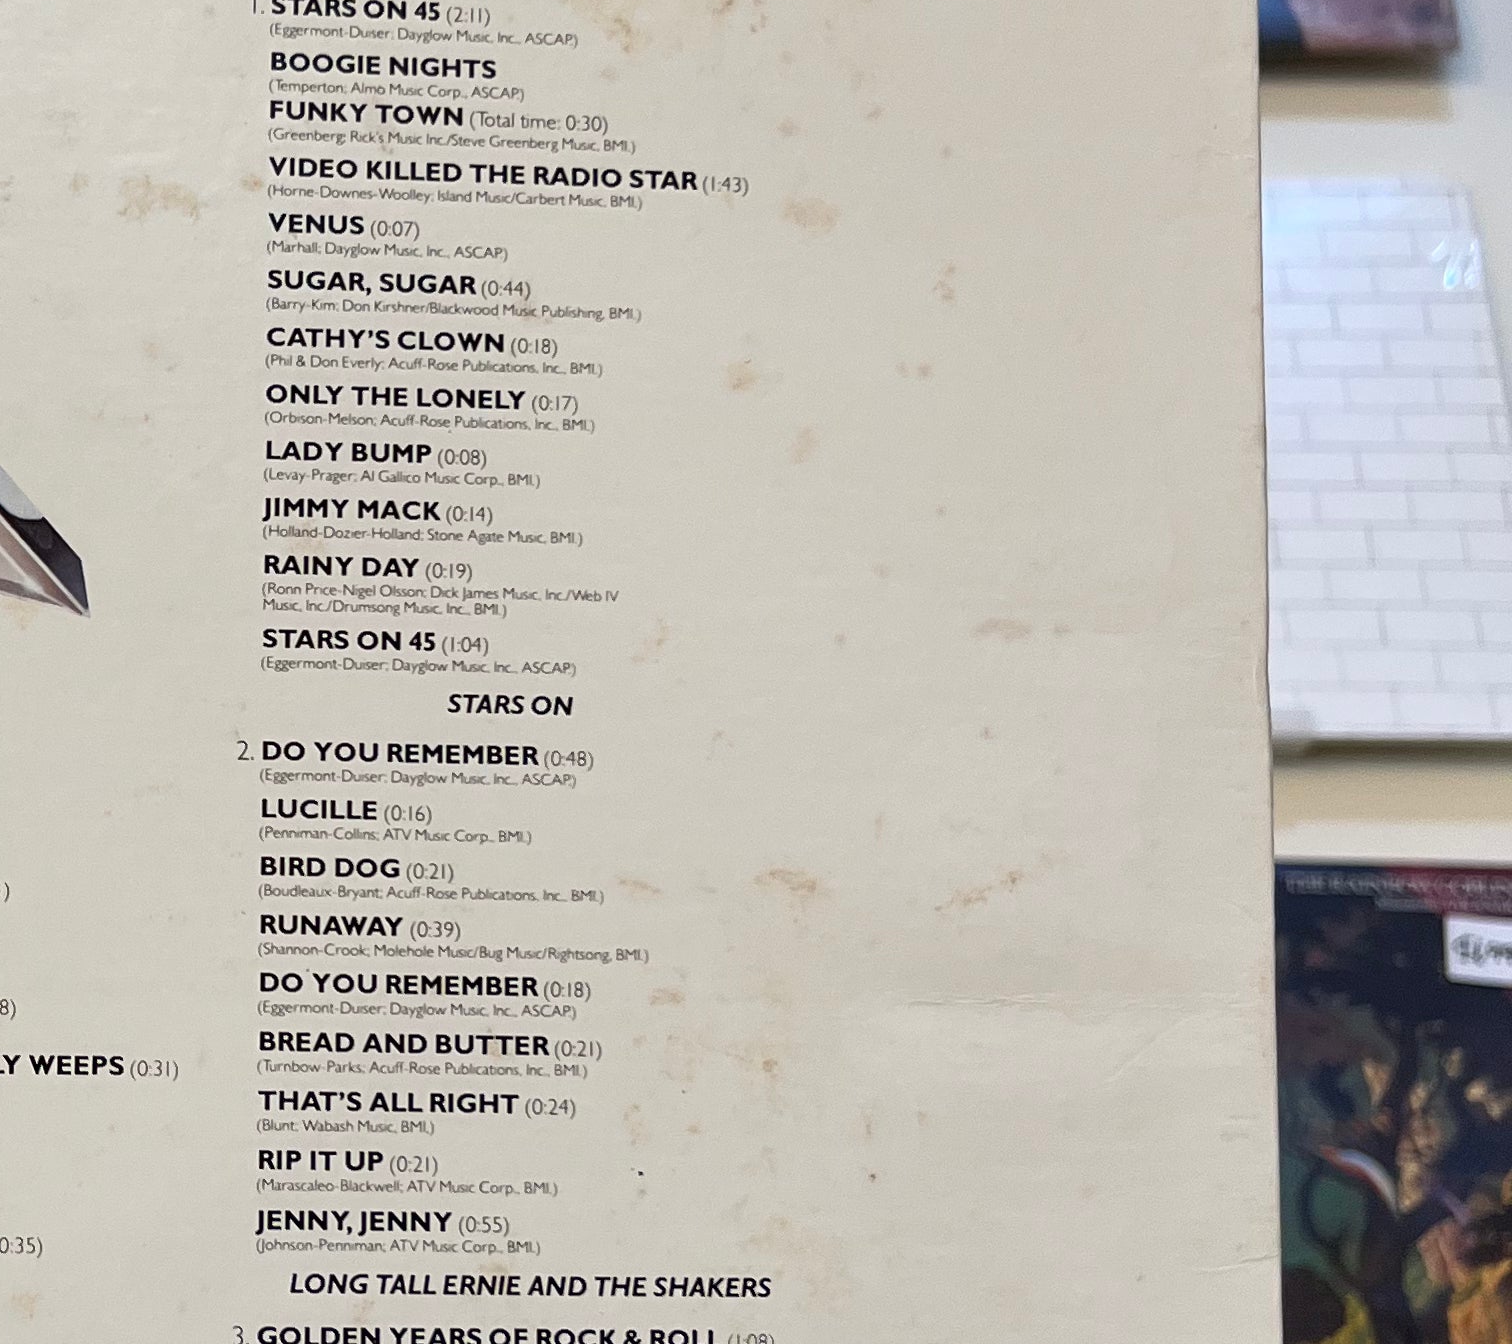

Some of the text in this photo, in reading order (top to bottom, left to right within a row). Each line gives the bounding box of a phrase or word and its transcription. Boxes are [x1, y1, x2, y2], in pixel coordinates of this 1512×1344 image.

[363, 0, 407, 20] ON
[414, 2, 441, 21] 45
[446, 6, 491, 27] (2:11)
[271, 51, 496, 79] BOOGIE NIGHTS
[270, 100, 368, 123] FUNKY
[375, 103, 463, 126] TOWN
[470, 110, 514, 131] (Total
[566, 114, 608, 135] 0:30)
[269, 156, 749, 197] VIDEO KILLED THE RADIO STAR (1:43)
[268, 269, 530, 301] SUGAR, SUGAR (0:44)
[448, 693, 573, 716] STARS ON
[237, 740, 593, 771] 2. DO YOU REMEMBER (0:48)
[290, 1273, 771, 1298] LONG TALL ERNIE AND THE SHAKERS
